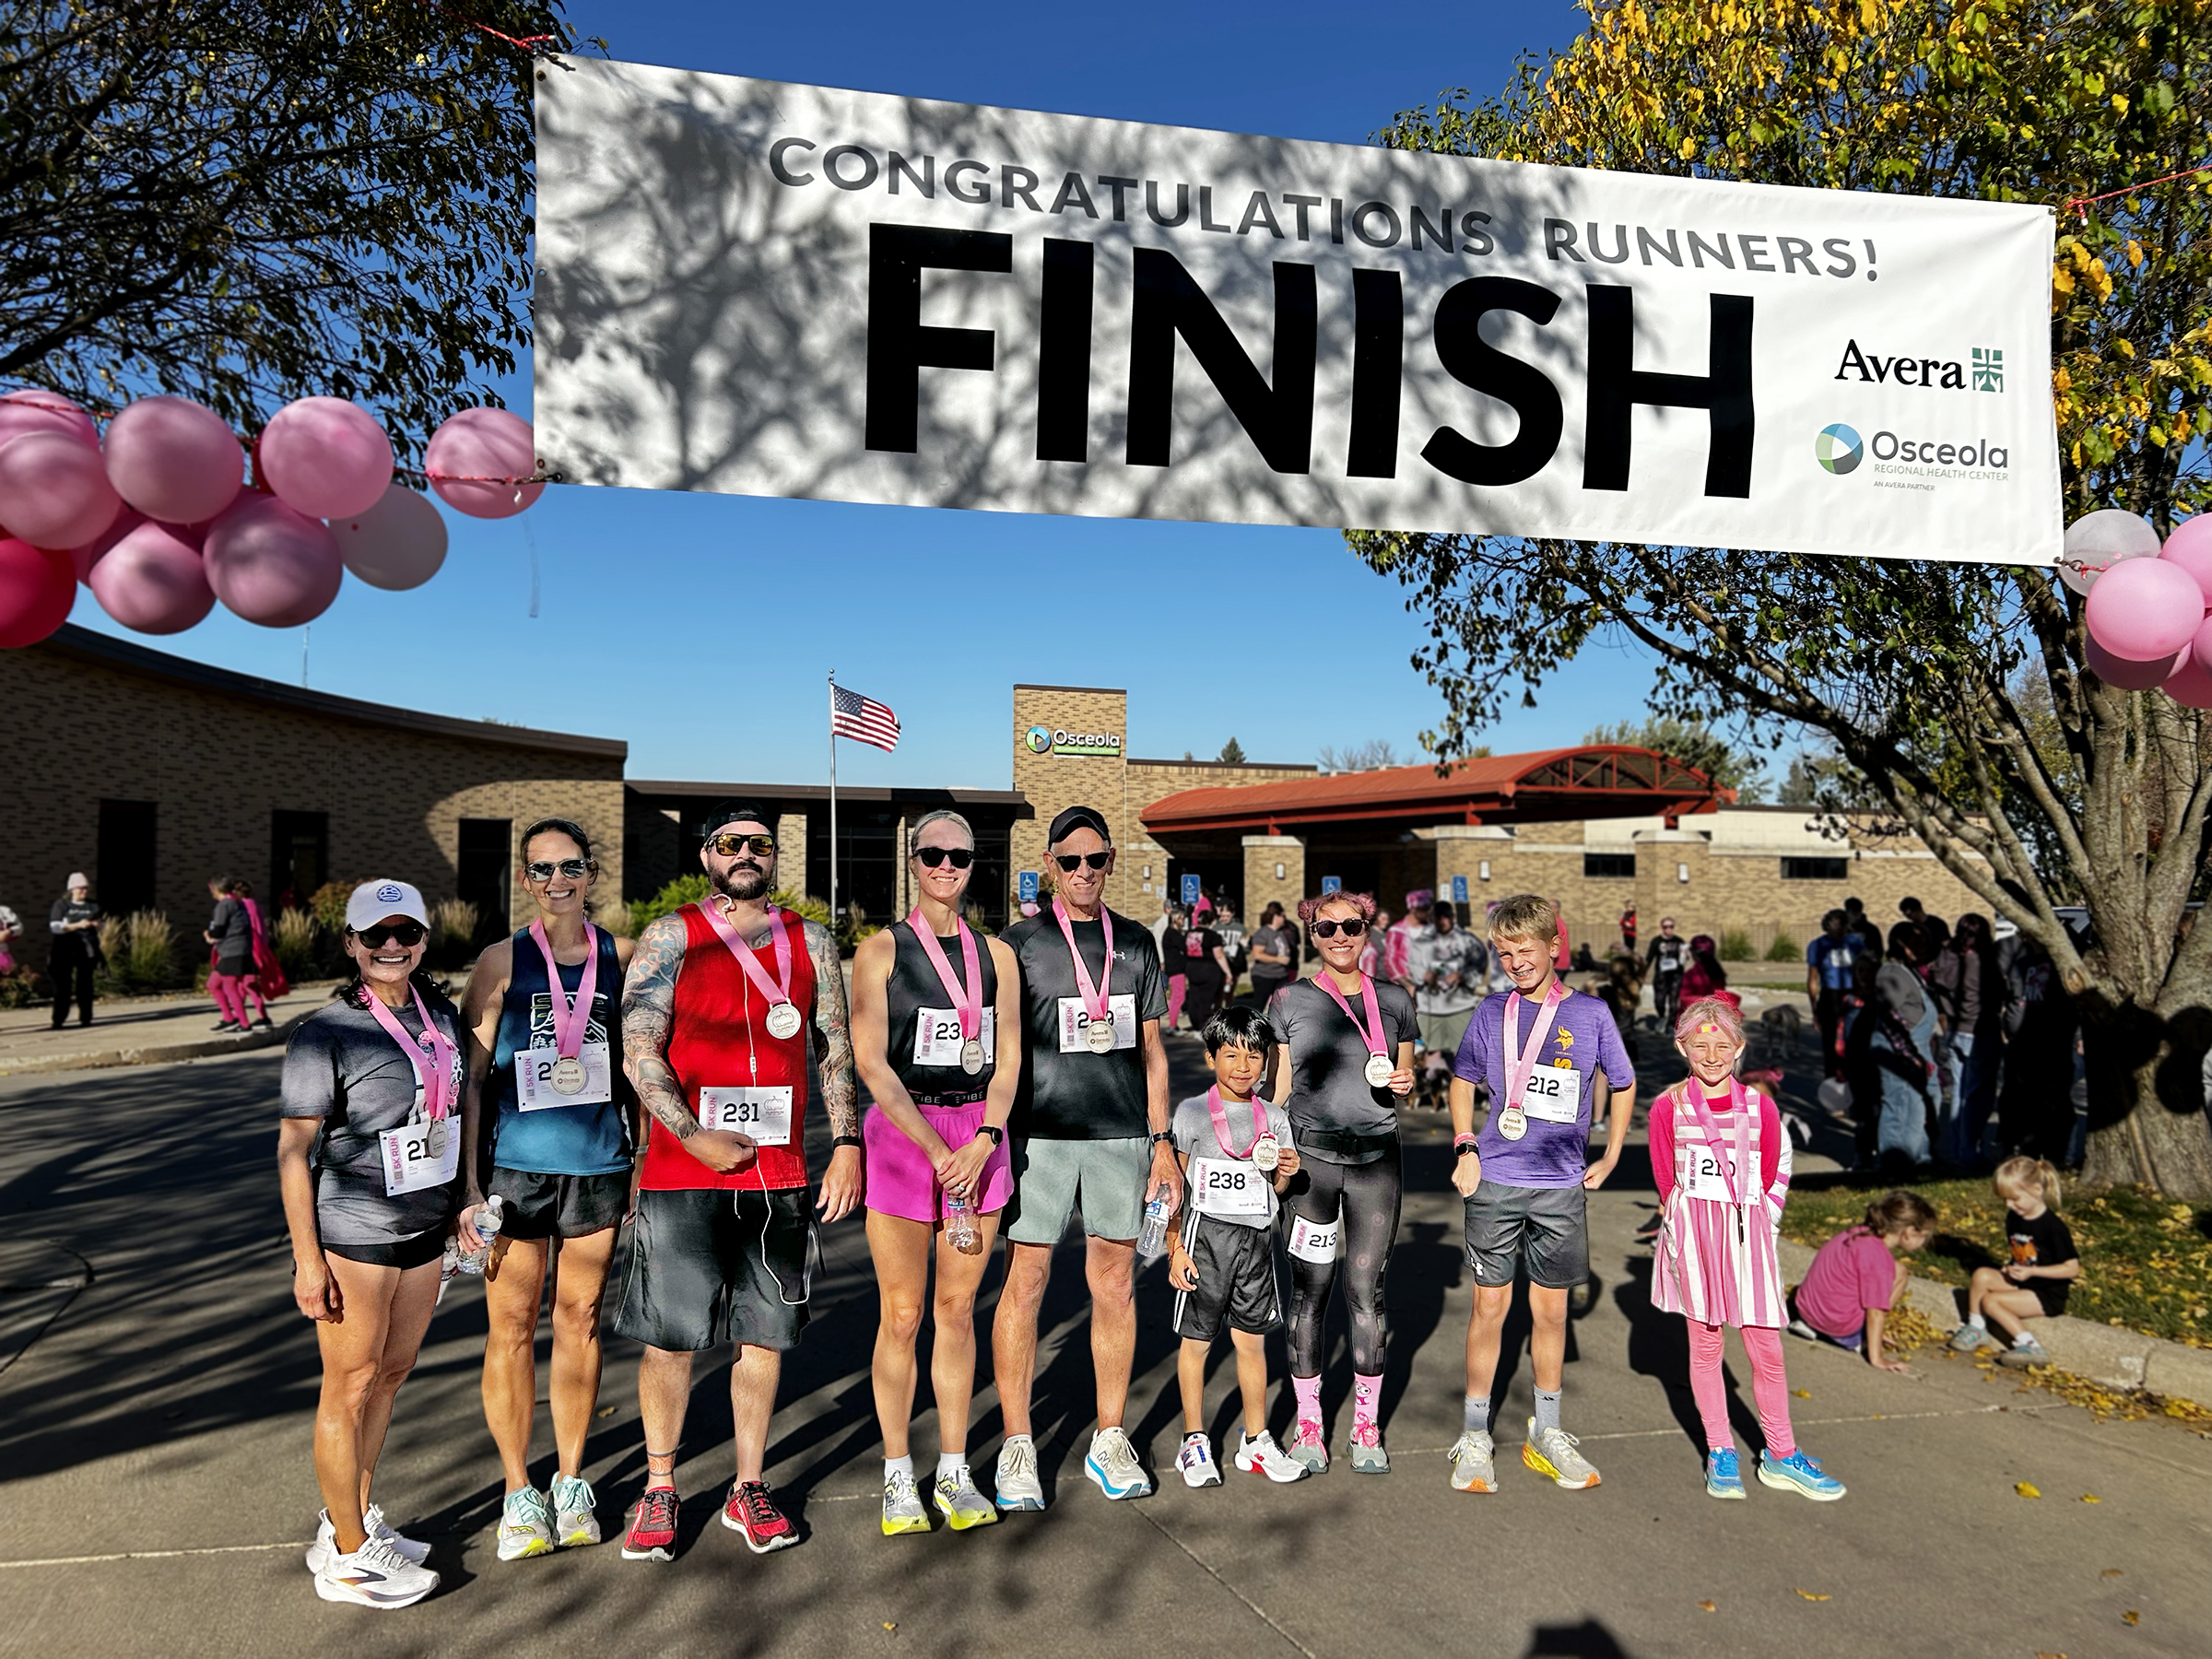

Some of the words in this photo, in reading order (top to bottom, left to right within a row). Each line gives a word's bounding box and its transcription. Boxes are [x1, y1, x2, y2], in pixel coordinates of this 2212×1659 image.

[769, 135, 1495, 256] CONGRATULATIONS
[1545, 217, 1878, 282] RUNNERS!
[865, 222, 1755, 499] FINISH
[1834, 338, 1967, 390] Avera
[1871, 430, 2008, 468] Osceola
[1874, 464, 1925, 477] REGIONAL
[1926, 467, 1967, 479] HEALTH
[1969, 470, 2009, 481] CENTER
[1885, 481, 1906, 489] AVERA
[1907, 483, 1936, 491] PARTNER
[1053, 728, 1120, 747] Osceola
[524, 1058, 533, 1076] RUN
[526, 1077, 534, 1088] 5K
[1526, 1076, 1559, 1097] 212
[708, 1115, 715, 1126] 5K
[723, 1102, 760, 1123] 231
[389, 1137, 400, 1157] RUN
[394, 1158, 402, 1170] 5K
[1209, 1171, 1245, 1190] 238
[1309, 1231, 1337, 1248] 213
